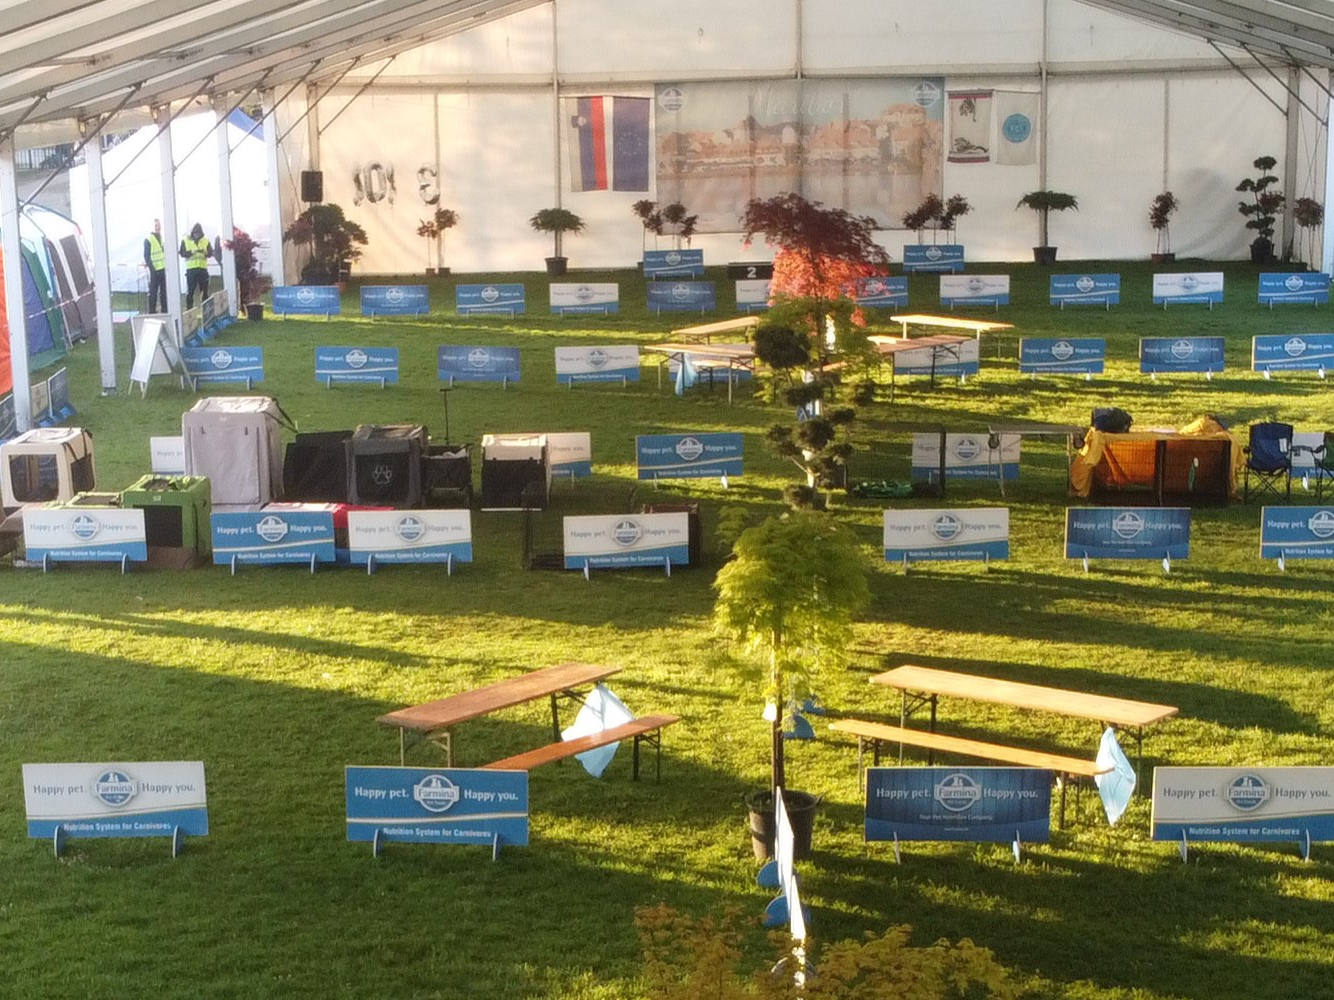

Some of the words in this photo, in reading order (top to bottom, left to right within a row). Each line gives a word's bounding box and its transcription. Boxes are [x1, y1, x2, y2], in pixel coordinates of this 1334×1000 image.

[747, 266, 757, 278] 2
[33, 785, 65, 795] Happy
[141, 783, 172, 793] Happy
[354, 786, 386, 799] Happy
[876, 788, 909, 799] Happy
[983, 787, 1015, 800] Happy
[1163, 787, 1196, 799] Happy
[1275, 787, 1307, 799] Happy
[464, 790, 496, 802] Happy
